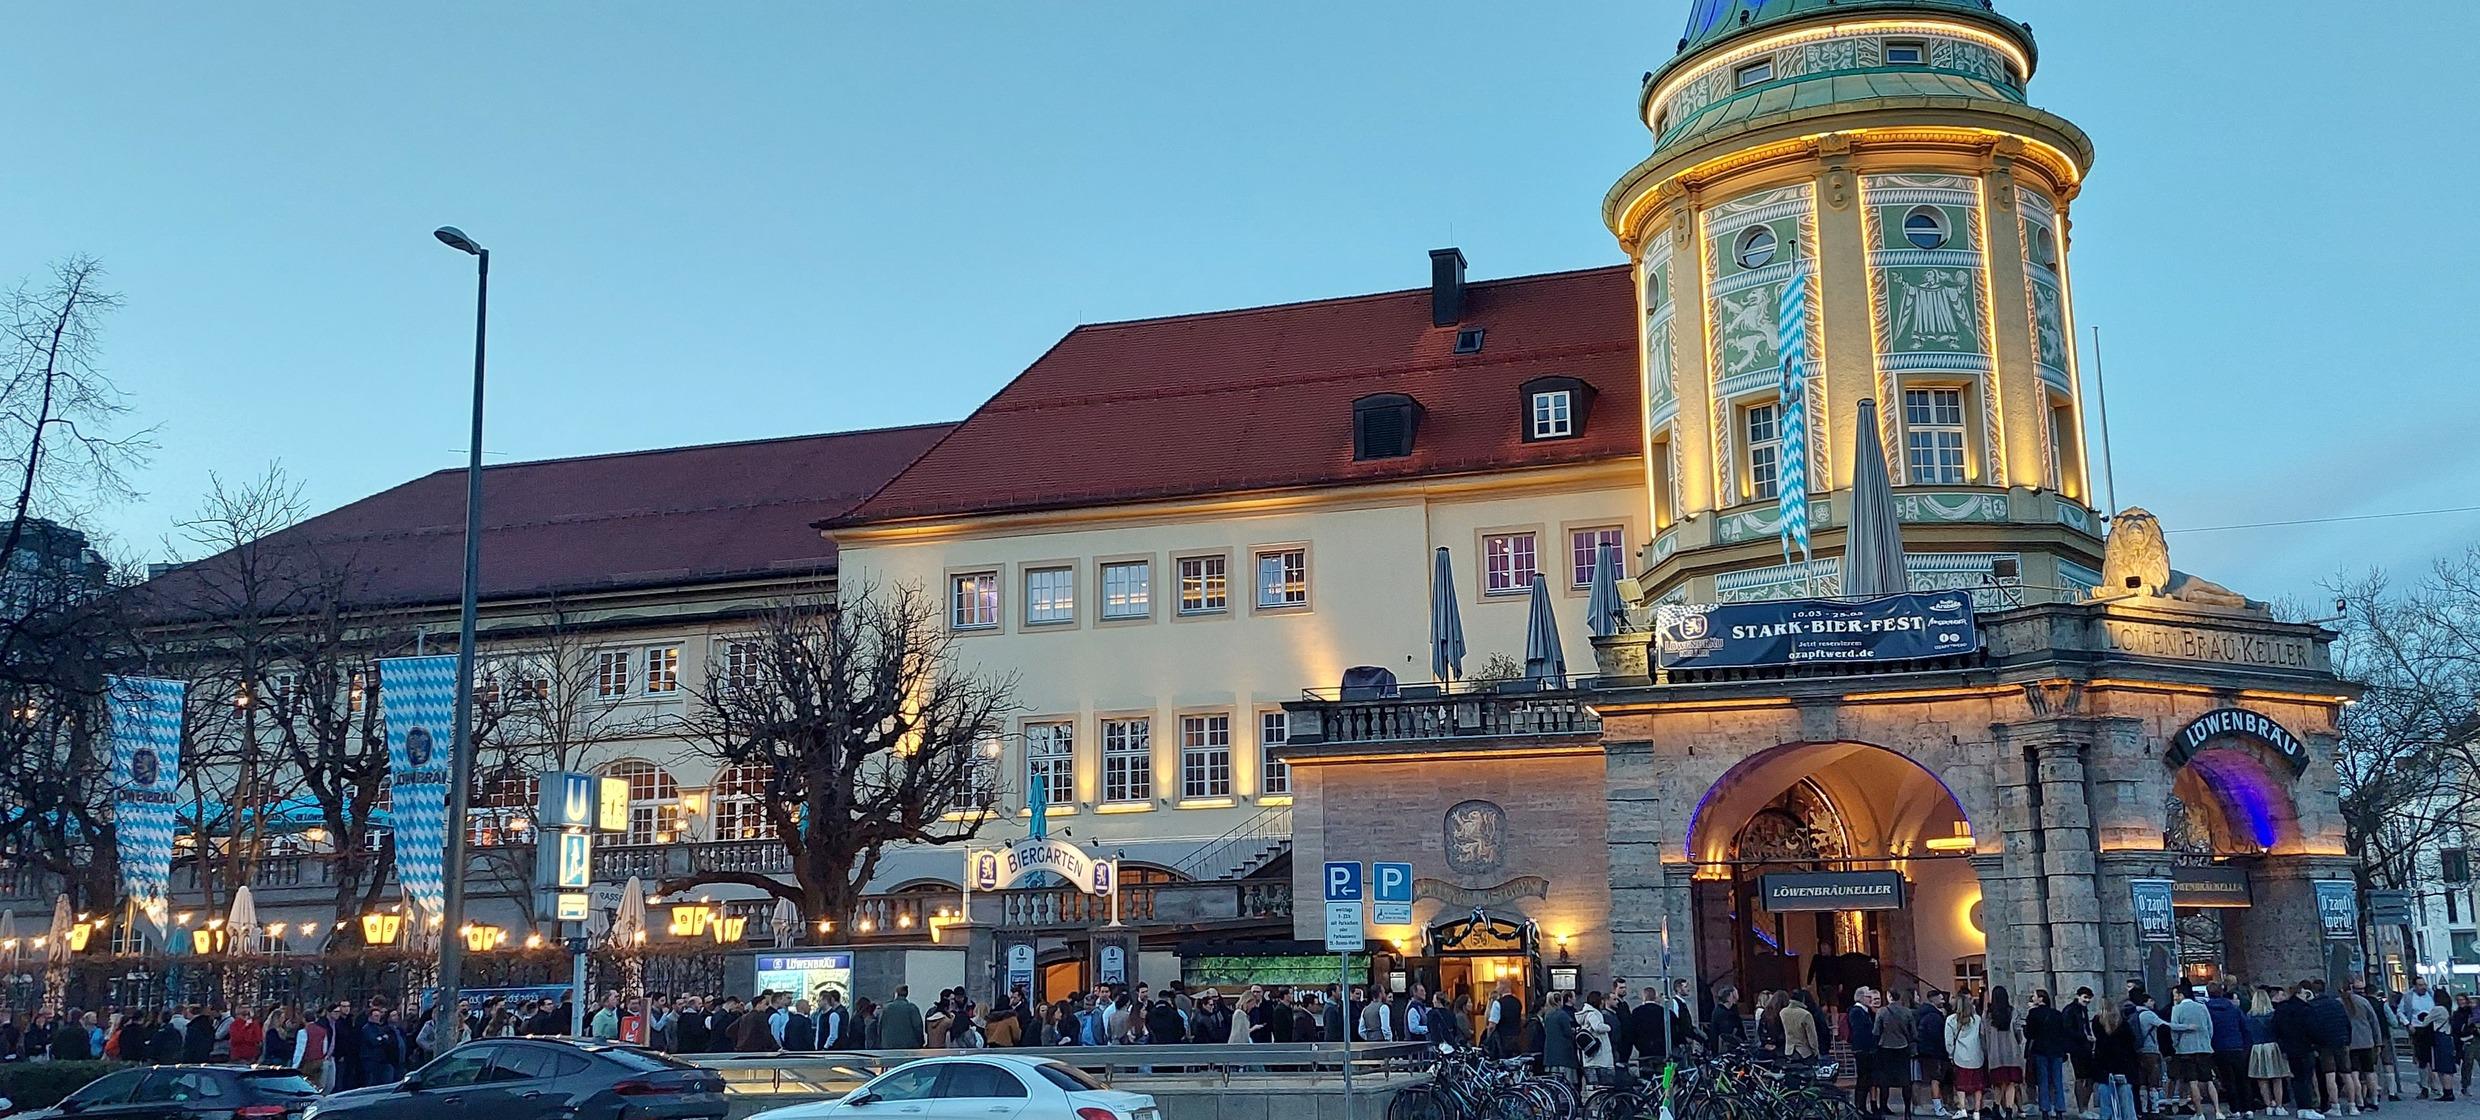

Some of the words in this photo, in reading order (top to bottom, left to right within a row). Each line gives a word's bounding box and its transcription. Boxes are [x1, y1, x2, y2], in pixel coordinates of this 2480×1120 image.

[1732, 616, 1923, 640] STARK-BIER-FEST
[1788, 649, 1875, 660] ozapftwerd.de
[2186, 711, 2298, 756] LÖWENBRÄU
[566, 778, 587, 822] U
[1007, 846, 1084, 878] BIERGARTEN
[1330, 867, 1351, 897] P
[1382, 868, 1403, 898] P
[1773, 884, 1892, 898] LÖWENBRÄUKELLER
[785, 956, 837, 970] LÖWENBRÄU
